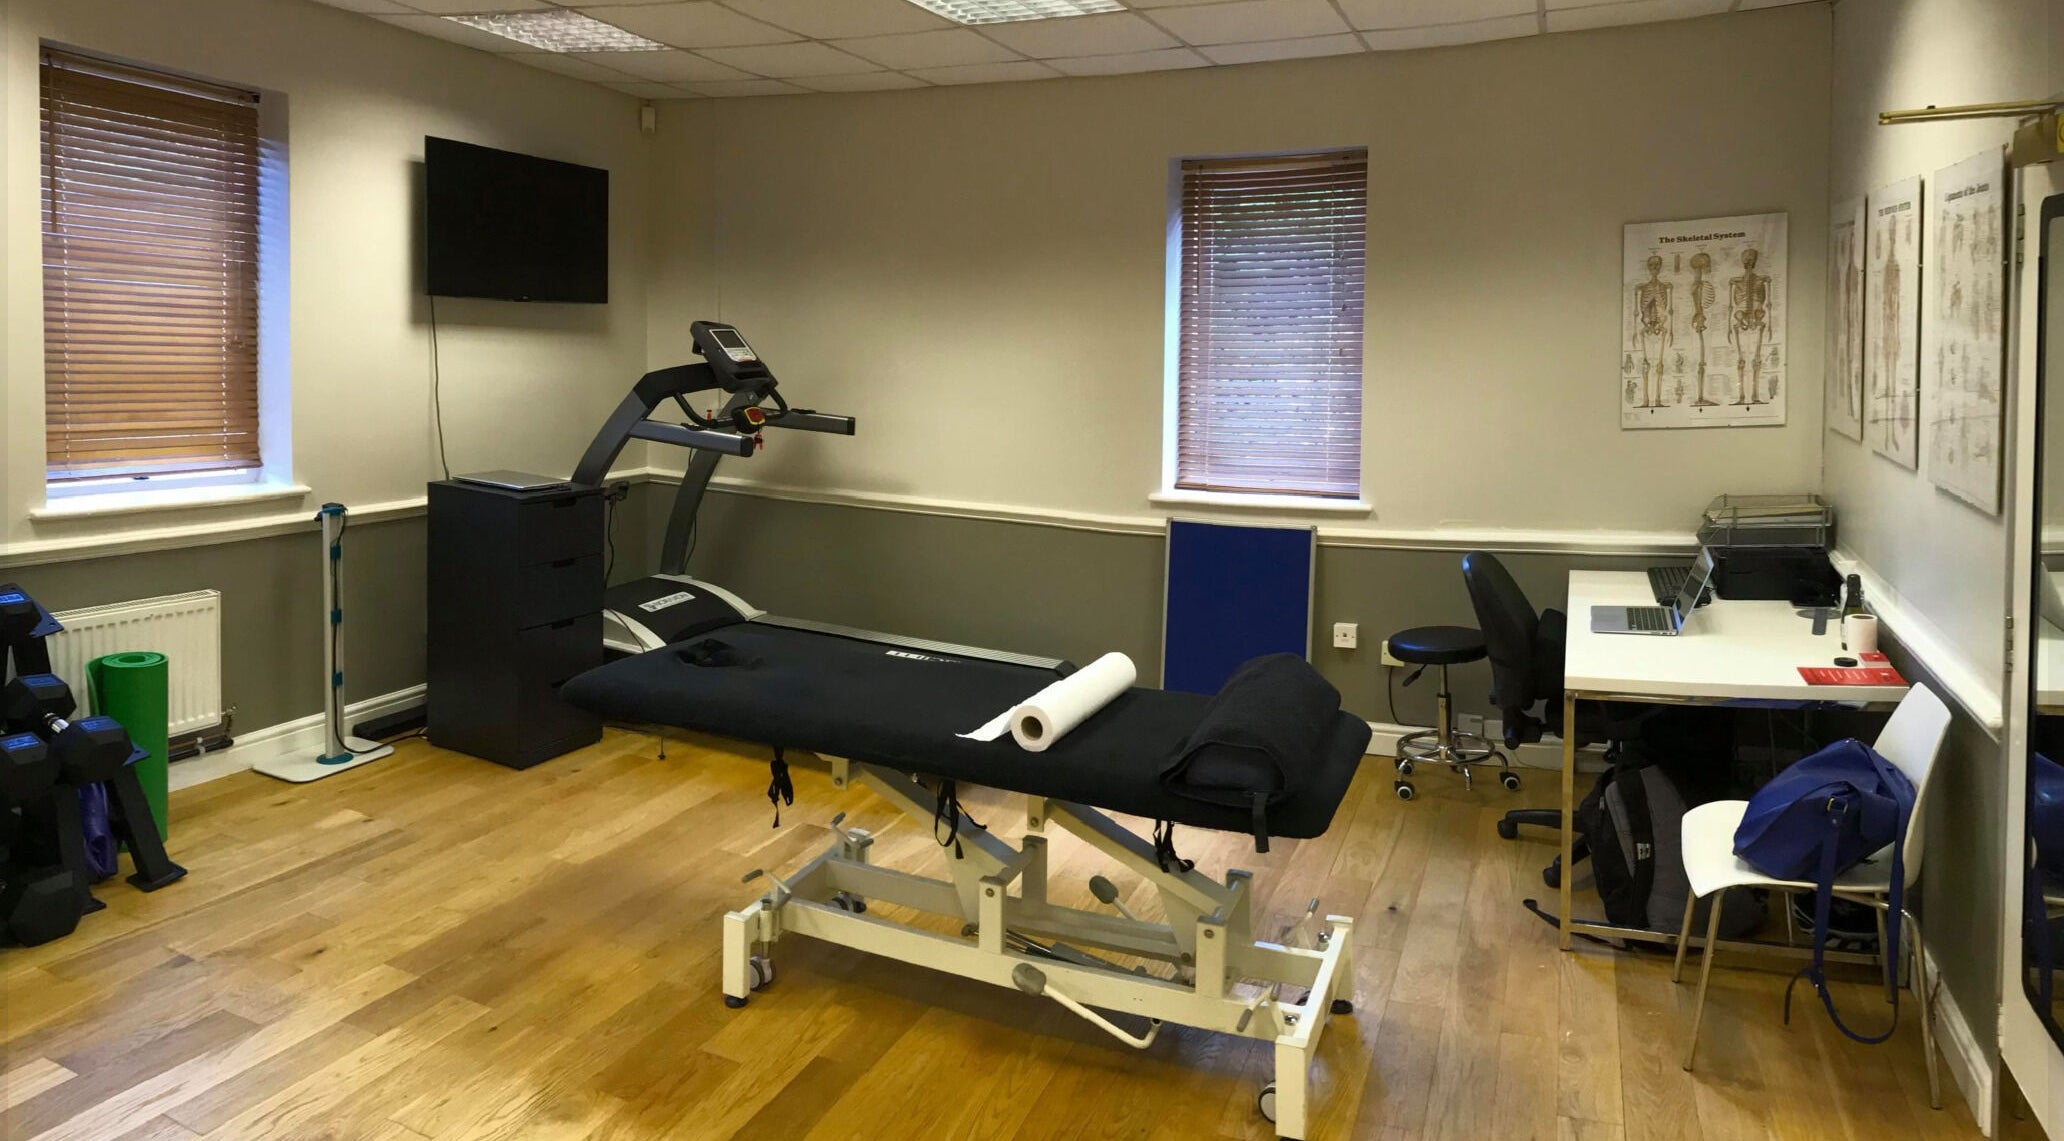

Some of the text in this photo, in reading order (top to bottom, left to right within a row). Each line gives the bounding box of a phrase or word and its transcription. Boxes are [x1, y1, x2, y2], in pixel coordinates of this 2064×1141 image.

[1659, 231, 1746, 244] The Skeletal System
